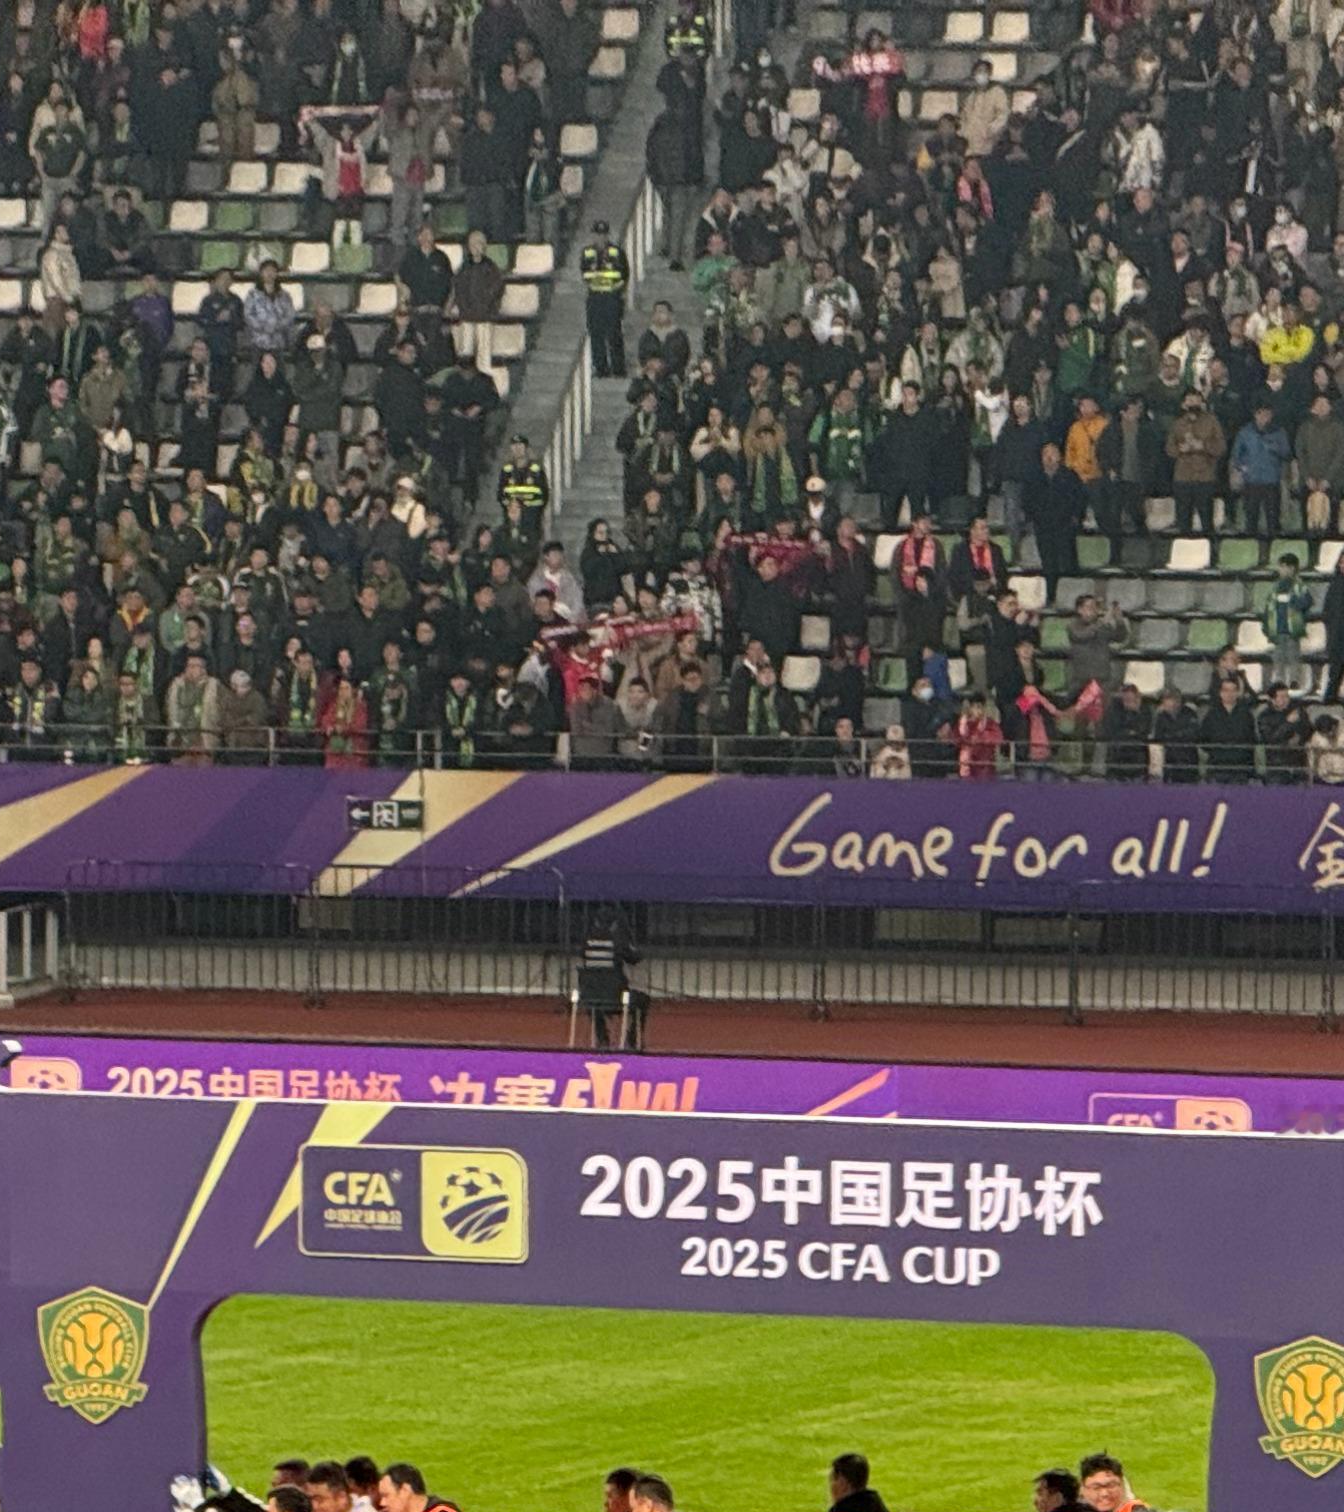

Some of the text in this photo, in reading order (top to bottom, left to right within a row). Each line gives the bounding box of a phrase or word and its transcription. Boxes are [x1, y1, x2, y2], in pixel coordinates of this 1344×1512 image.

[768, 792, 1228, 886] Game for all!
[323, 1171, 395, 1206] CFA
[579, 1153, 1104, 1237] 2025中国足协杯
[680, 1236, 1001, 1287] 2025 CFA CUP
